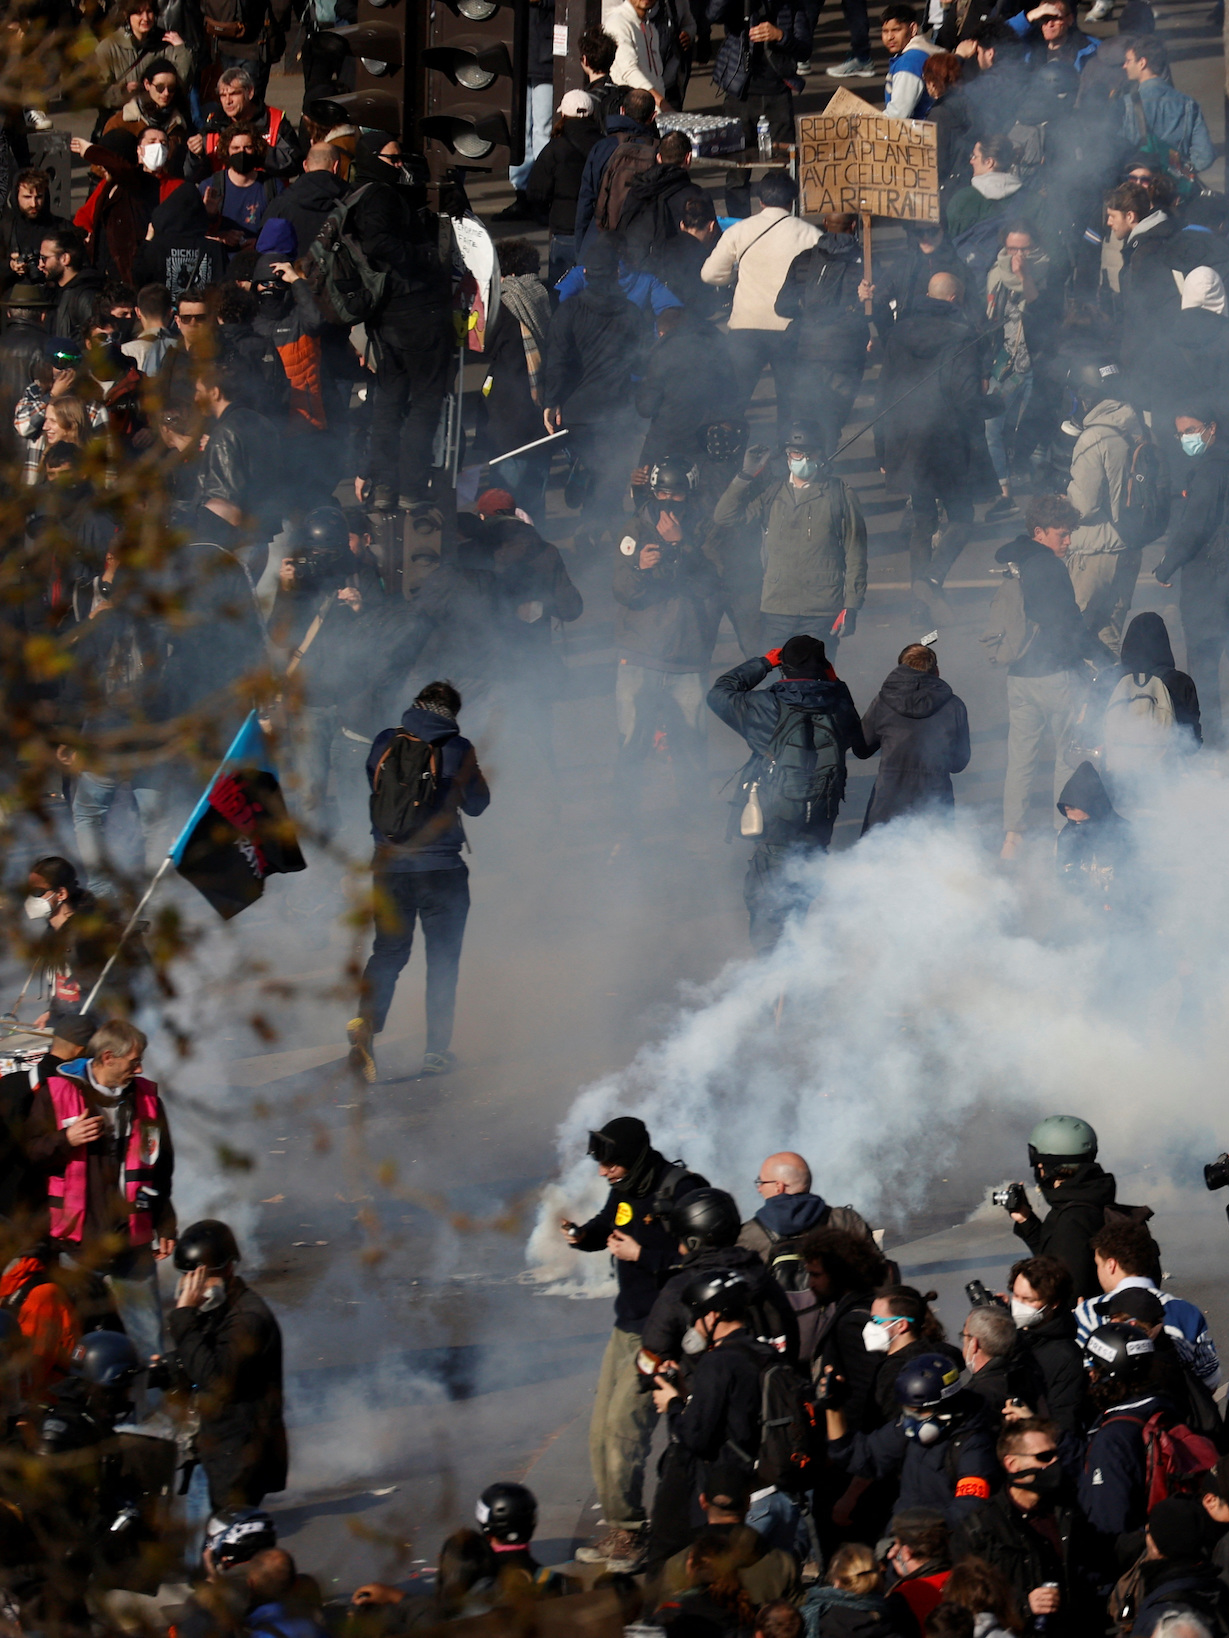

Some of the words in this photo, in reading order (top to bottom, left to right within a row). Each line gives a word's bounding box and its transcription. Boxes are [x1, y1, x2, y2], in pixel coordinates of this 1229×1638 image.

[801, 116, 885, 143] REPORTE
[802, 143, 829, 165] DE
[833, 141, 858, 161] LA
[860, 141, 937, 168] PLANETE
[802, 163, 842, 189] AVT
[844, 163, 897, 186] CELUI
[903, 167, 931, 189] DE
[803, 189, 836, 213] LA
[840, 187, 938, 219] RETRAITE
